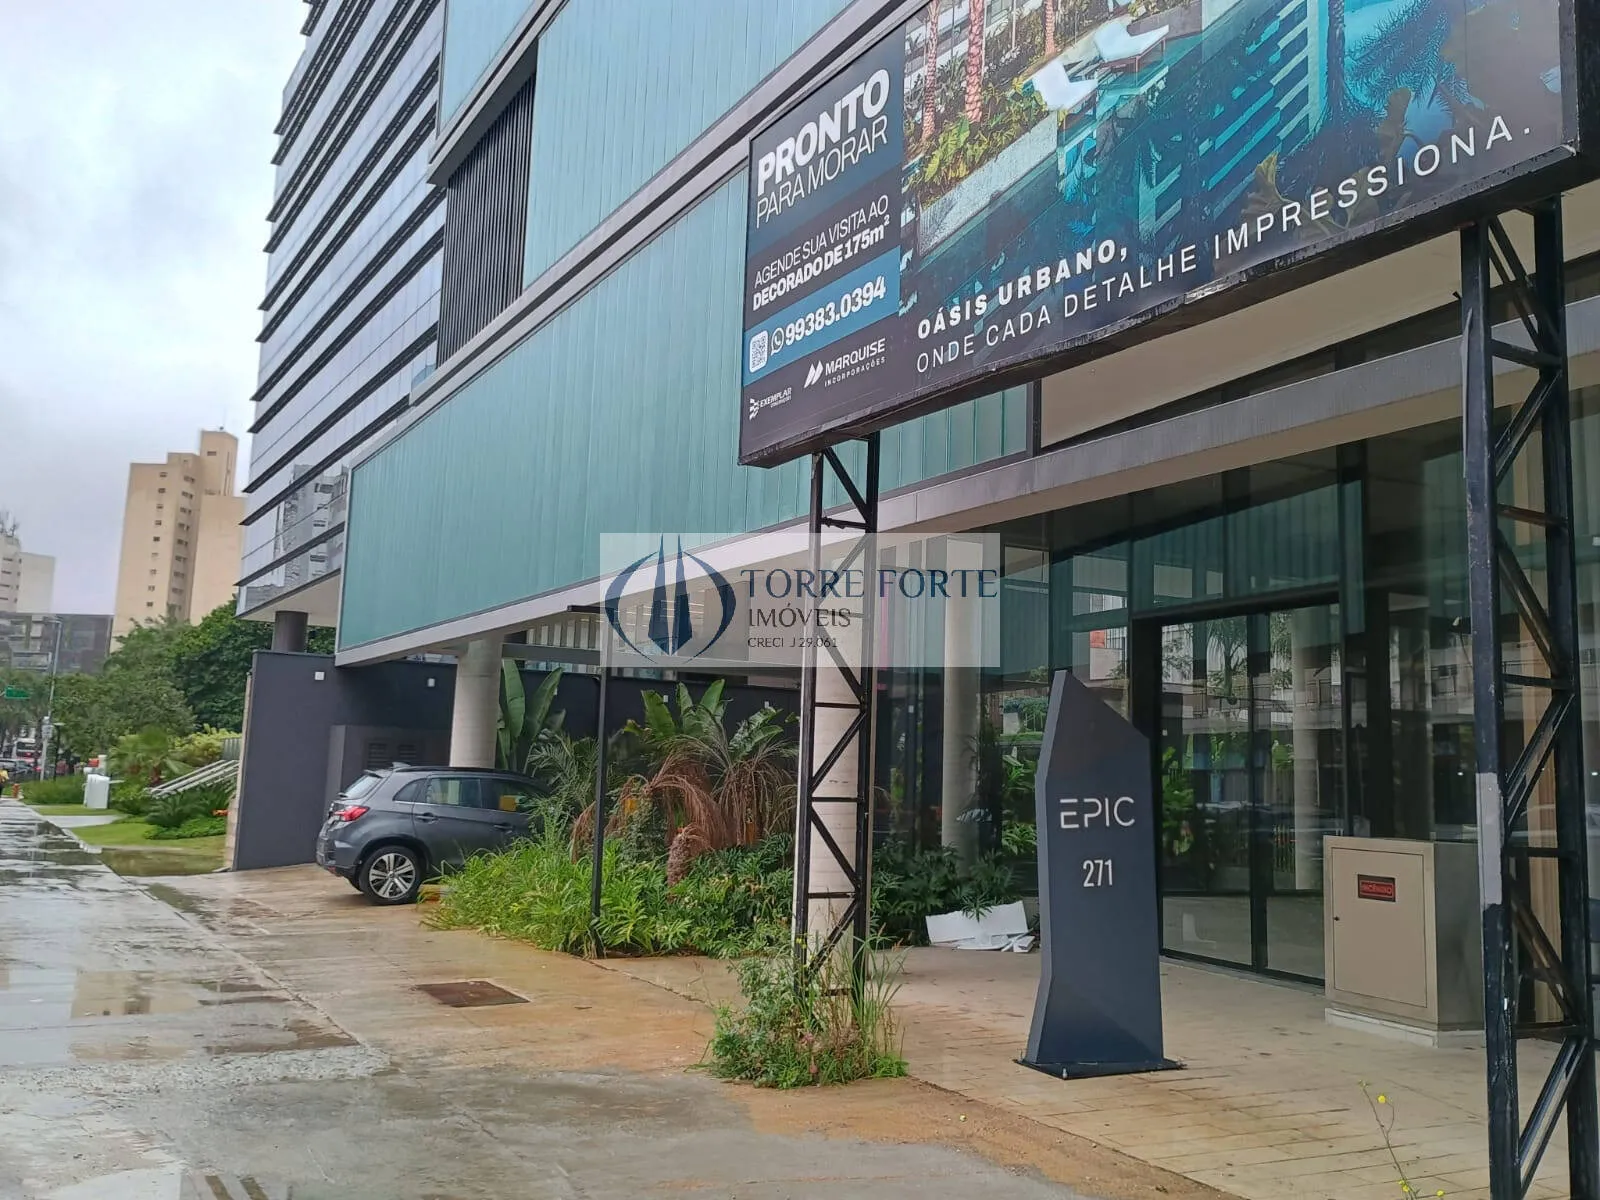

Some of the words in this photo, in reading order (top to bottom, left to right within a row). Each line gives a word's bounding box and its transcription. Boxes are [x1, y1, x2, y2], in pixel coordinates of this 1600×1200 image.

[757, 68, 890, 197] PRONTO
[756, 181, 806, 229] PARA
[807, 114, 888, 194] MORAR
[752, 256, 824, 312] DECORADO
[824, 242, 843, 272] DE
[754, 249, 801, 289] AGENDE
[802, 231, 828, 260] SUA
[828, 207, 866, 245] VISITA
[868, 194, 890, 221] AO
[916, 334, 976, 374] ONDE
[985, 305, 1051, 347] CADA
[1064, 244, 1197, 318] DETALHE
[1213, 115, 1531, 260] IMPRESSIONA.
[785, 275, 887, 347] 99383.0394
[917, 294, 988, 340] OÁSIS
[998, 239, 1128, 306] URBANO,
[824, 356, 887, 388] INCORPORAÇÕES
[825, 337, 887, 376] MARQUISE
[1059, 796, 1135, 829] EPIC
[1082, 859, 1113, 887] 271
